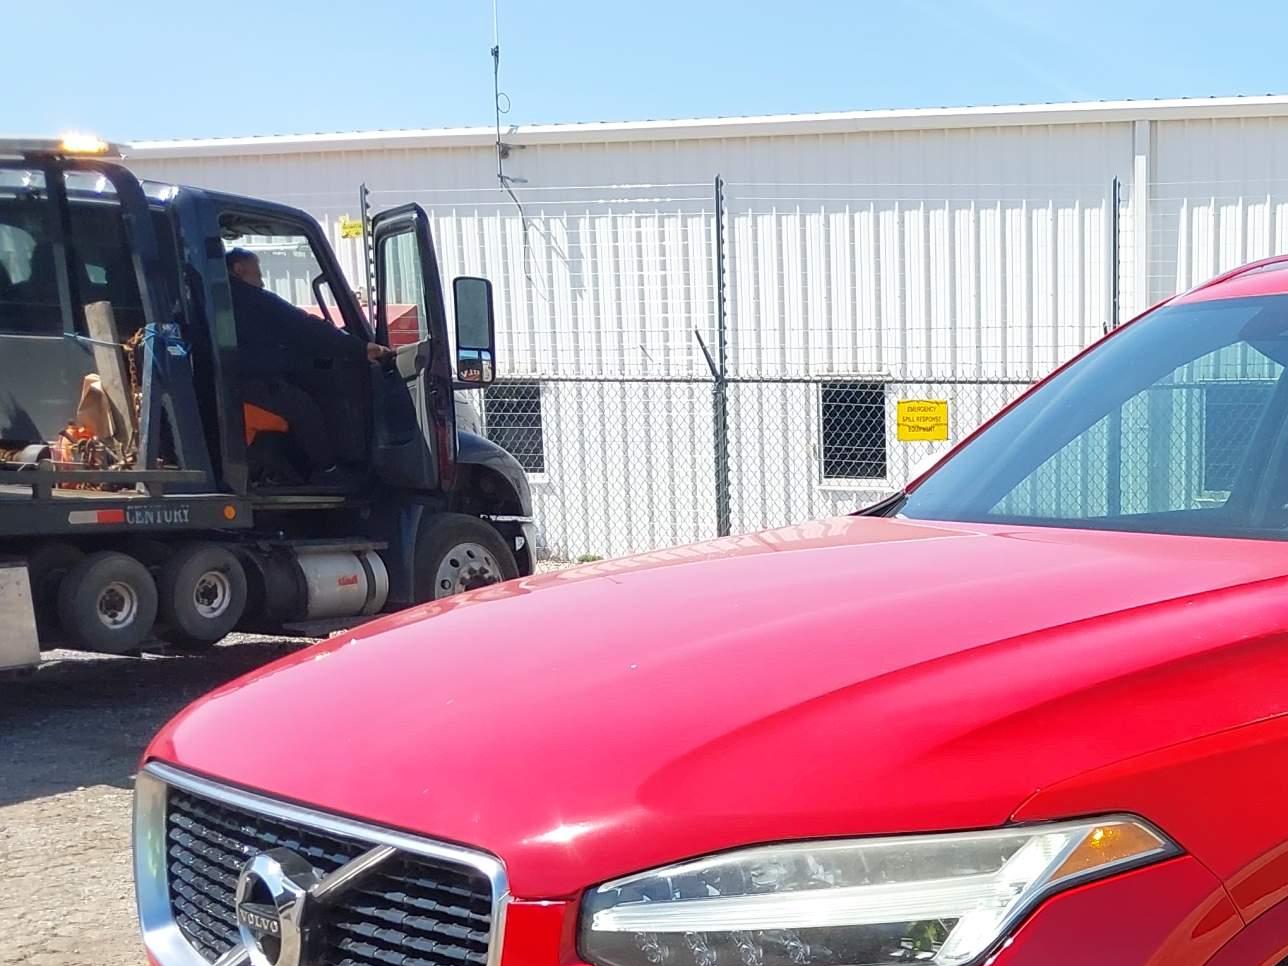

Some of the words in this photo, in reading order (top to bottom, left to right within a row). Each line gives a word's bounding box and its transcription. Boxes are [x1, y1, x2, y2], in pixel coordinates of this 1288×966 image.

[907, 405, 936, 413] EMERGENCY
[902, 415, 915, 423] SPILL
[916, 415, 941, 423] RESPONSE
[126, 504, 190, 524] CENTURY
[240, 911, 279, 933] VOLVO
